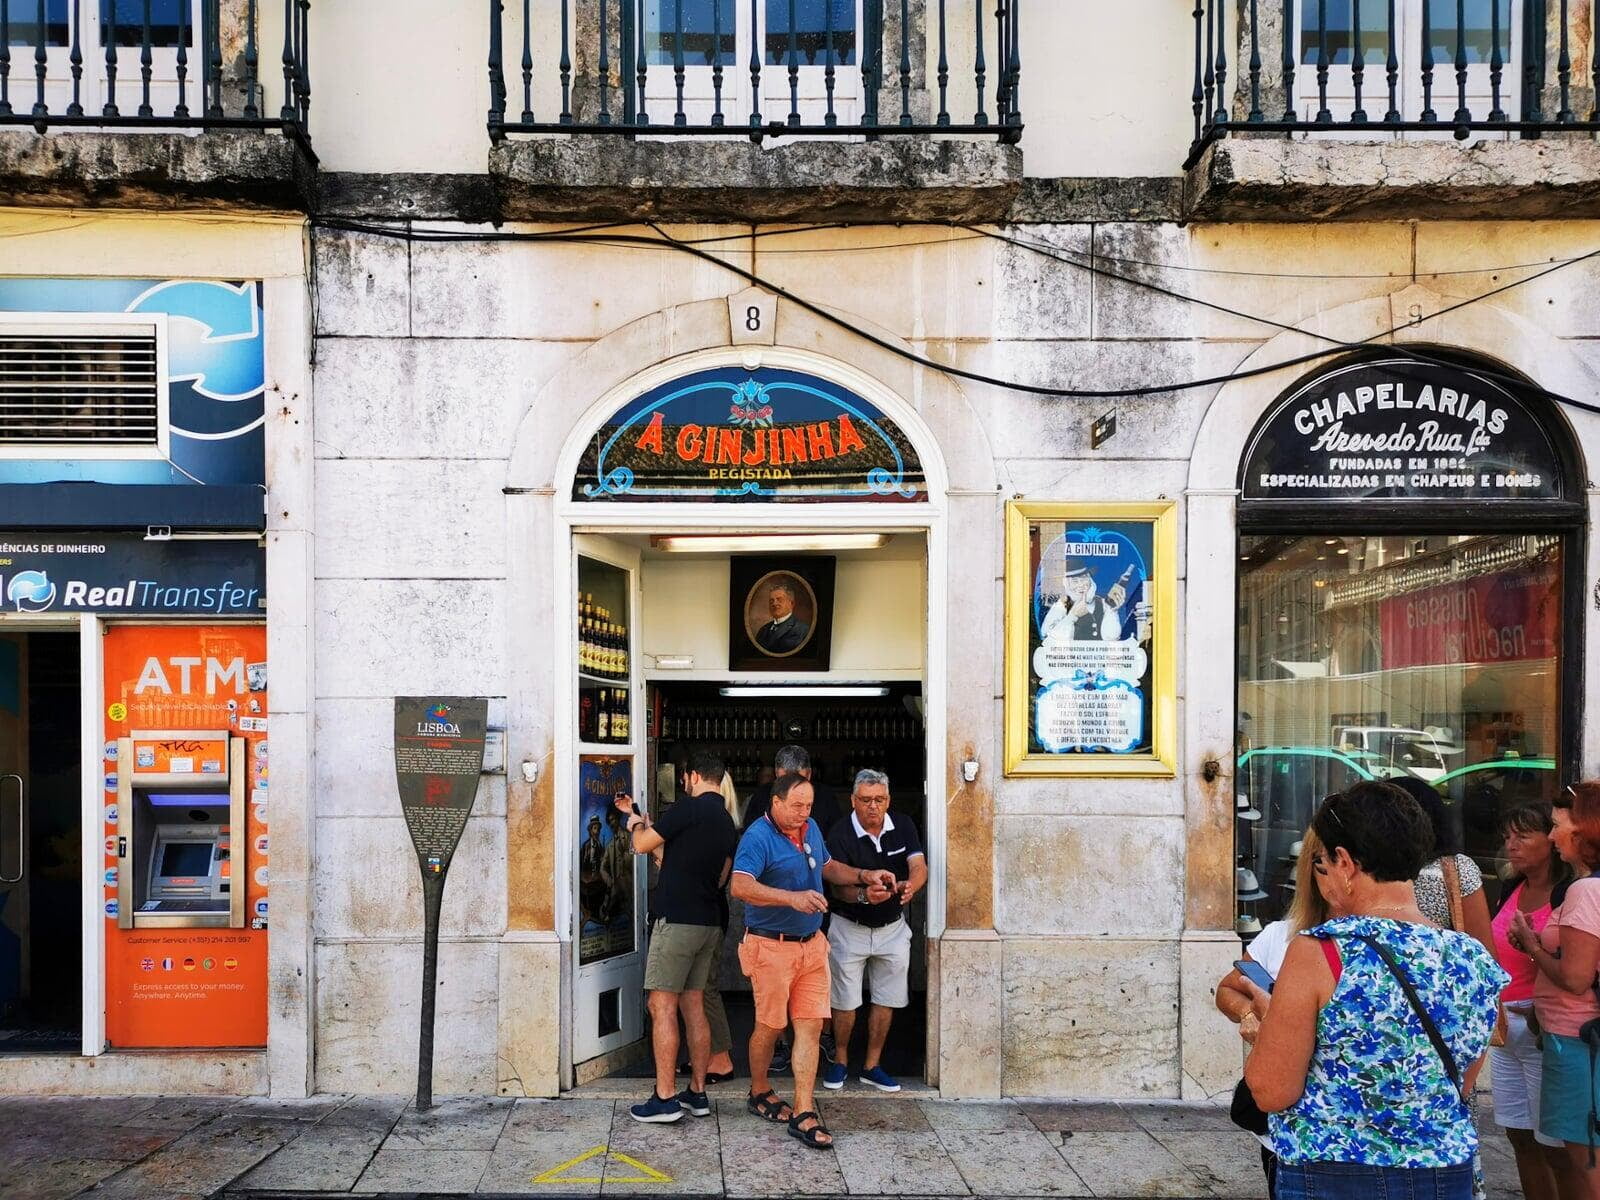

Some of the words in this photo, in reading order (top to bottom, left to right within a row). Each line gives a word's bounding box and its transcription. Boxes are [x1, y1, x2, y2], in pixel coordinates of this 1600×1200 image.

[746, 306, 760, 331] 8
[1294, 383, 1509, 435] CHAPELARIAS
[634, 411, 665, 455] A
[676, 413, 867, 466] GINJINHA
[1310, 421, 1415, 452] Azevedo
[1329, 457, 1403, 471] FUNDADAS
[1408, 457, 1428, 471] EM
[708, 467, 793, 481] REGISTADA
[1259, 474, 1380, 488] ESPECIALIZADAS
[1385, 474, 1405, 488] EM
[1410, 474, 1475, 488] CHAPEUS
[1481, 474, 1490, 488] E
[41, 544, 55, 553] DE
[56, 544, 106, 553] DINHEIRO
[1066, 543, 1073, 556] A
[1075, 543, 1118, 556] GINJINHA
[134, 656, 245, 695] ATM
[417, 721, 462, 734] LISBOA
[1081, 719, 1102, 727] MUNDO
[127, 936, 161, 944] Customer
[162, 936, 187, 944] Service
[133, 983, 162, 992] Express
[200, 984, 217, 992] your
